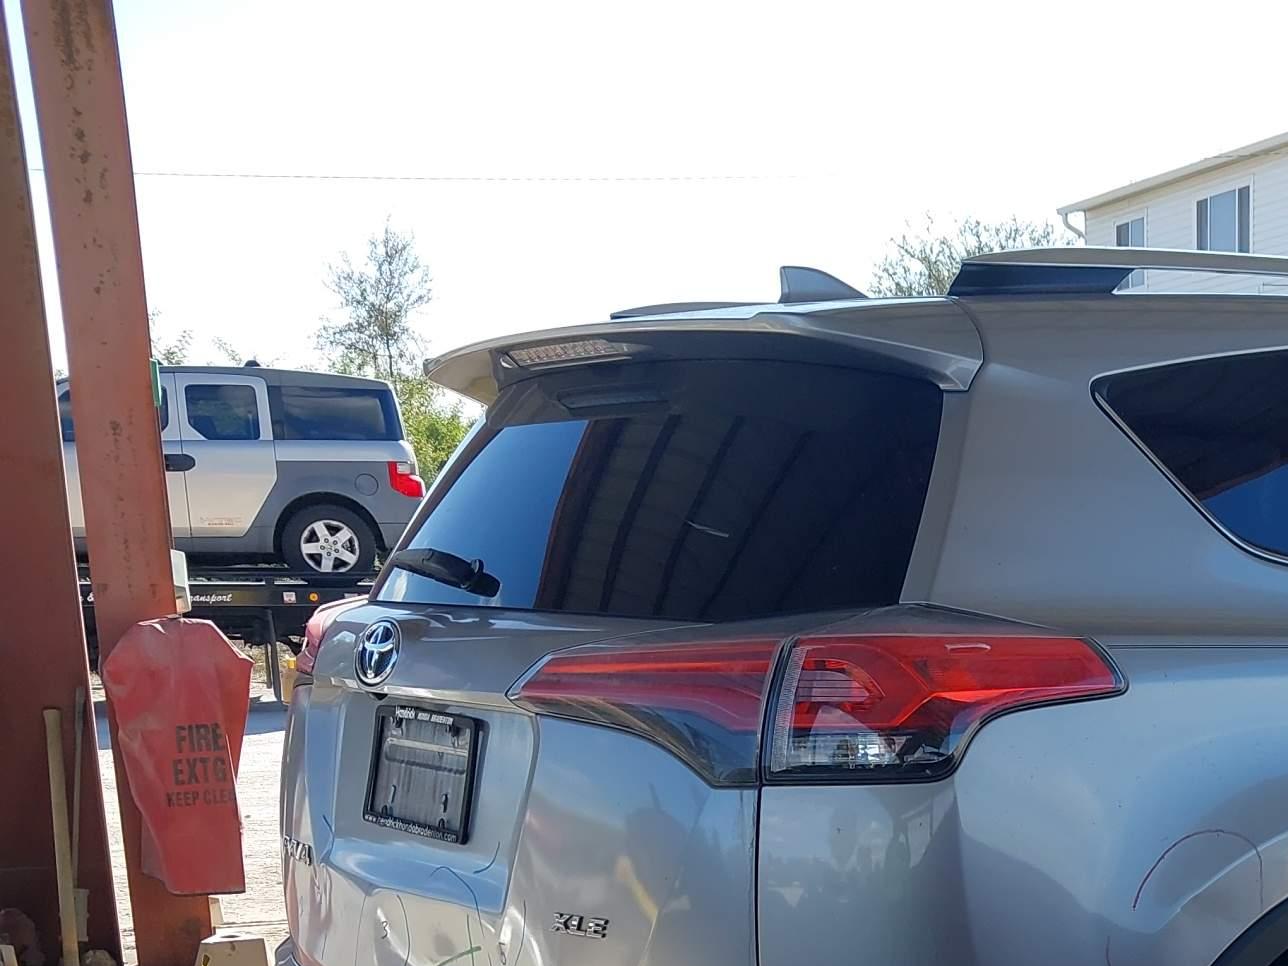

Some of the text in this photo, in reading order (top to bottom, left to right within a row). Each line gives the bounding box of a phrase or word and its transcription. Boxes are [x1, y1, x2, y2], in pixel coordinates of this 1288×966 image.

[188, 593, 233, 604] ransport
[175, 722, 226, 753] FIRE
[172, 756, 227, 786] EXTG
[166, 791, 200, 808] KEEP
[550, 912, 609, 938] XLE
